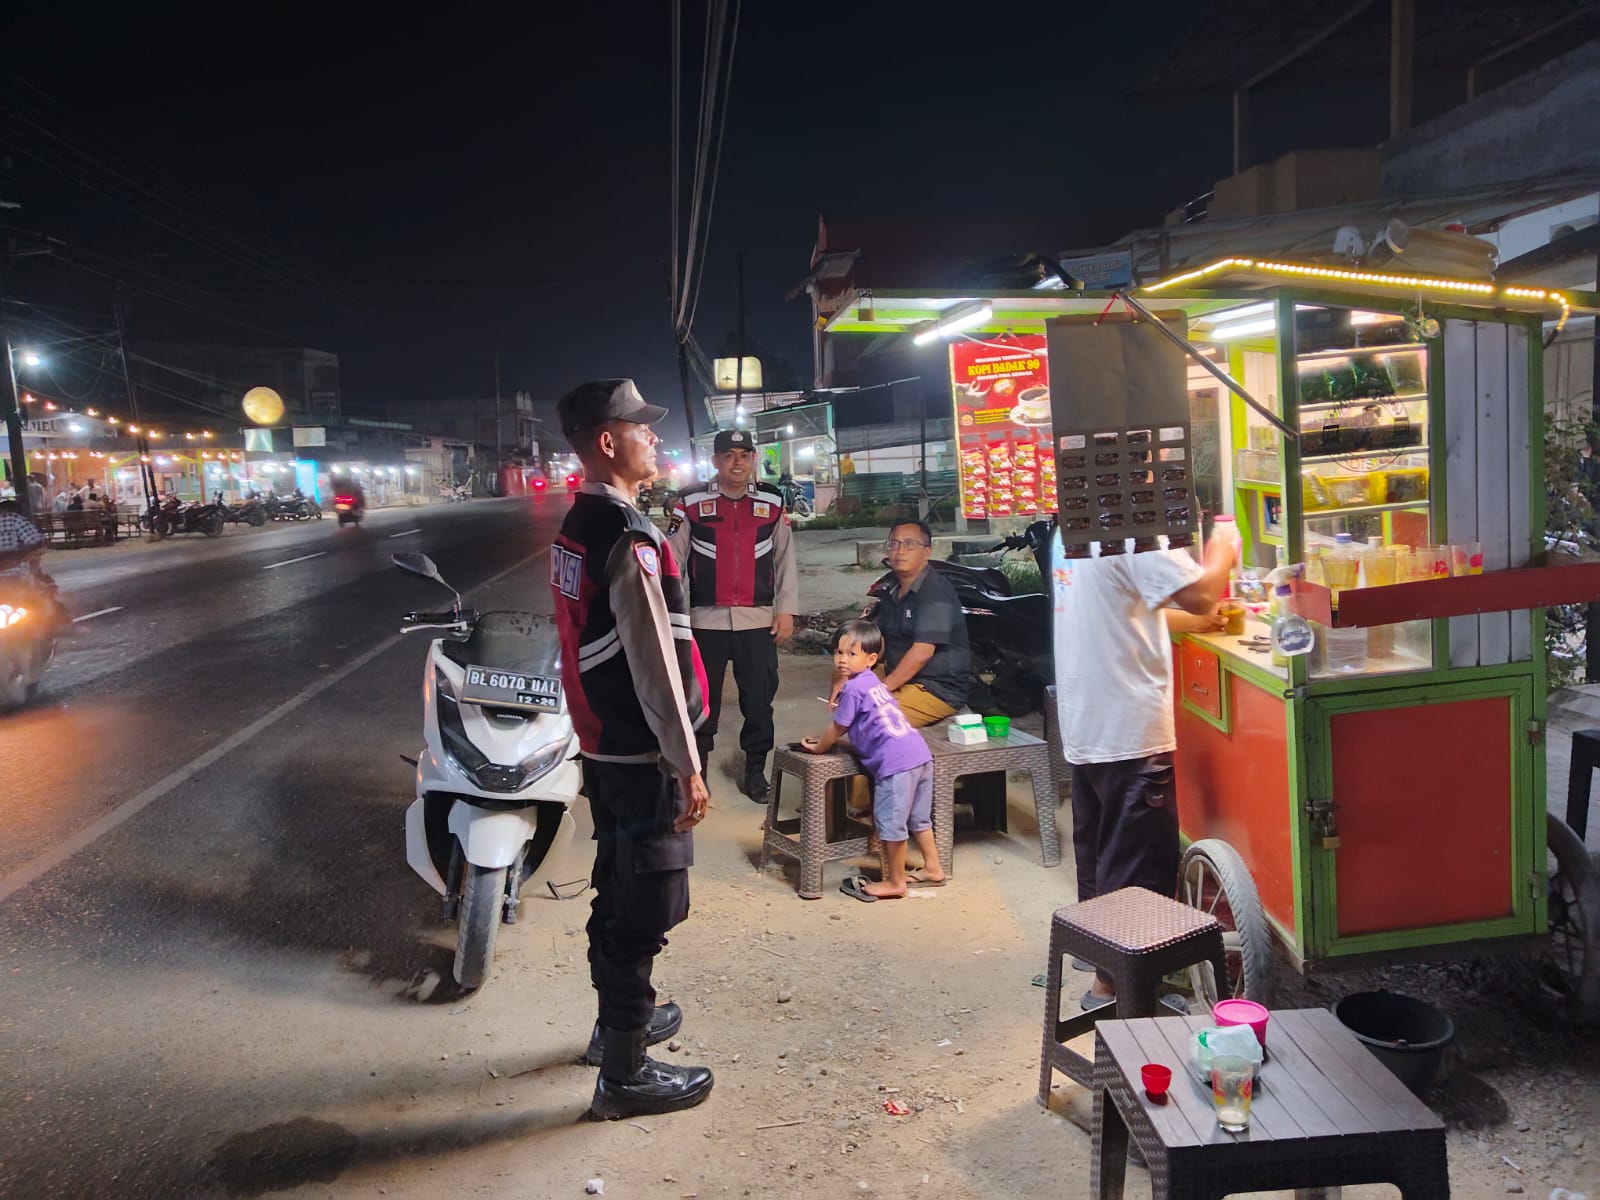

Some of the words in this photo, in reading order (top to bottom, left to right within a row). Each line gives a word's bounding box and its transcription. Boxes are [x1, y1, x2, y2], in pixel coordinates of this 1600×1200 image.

[968, 364, 992, 376] KOPI
[992, 361, 1026, 373] BADAK
[1027, 359, 1040, 369] 99
[471, 671, 487, 686] BL
[490, 676, 525, 690] 6070
[531, 680, 557, 694] UAL
